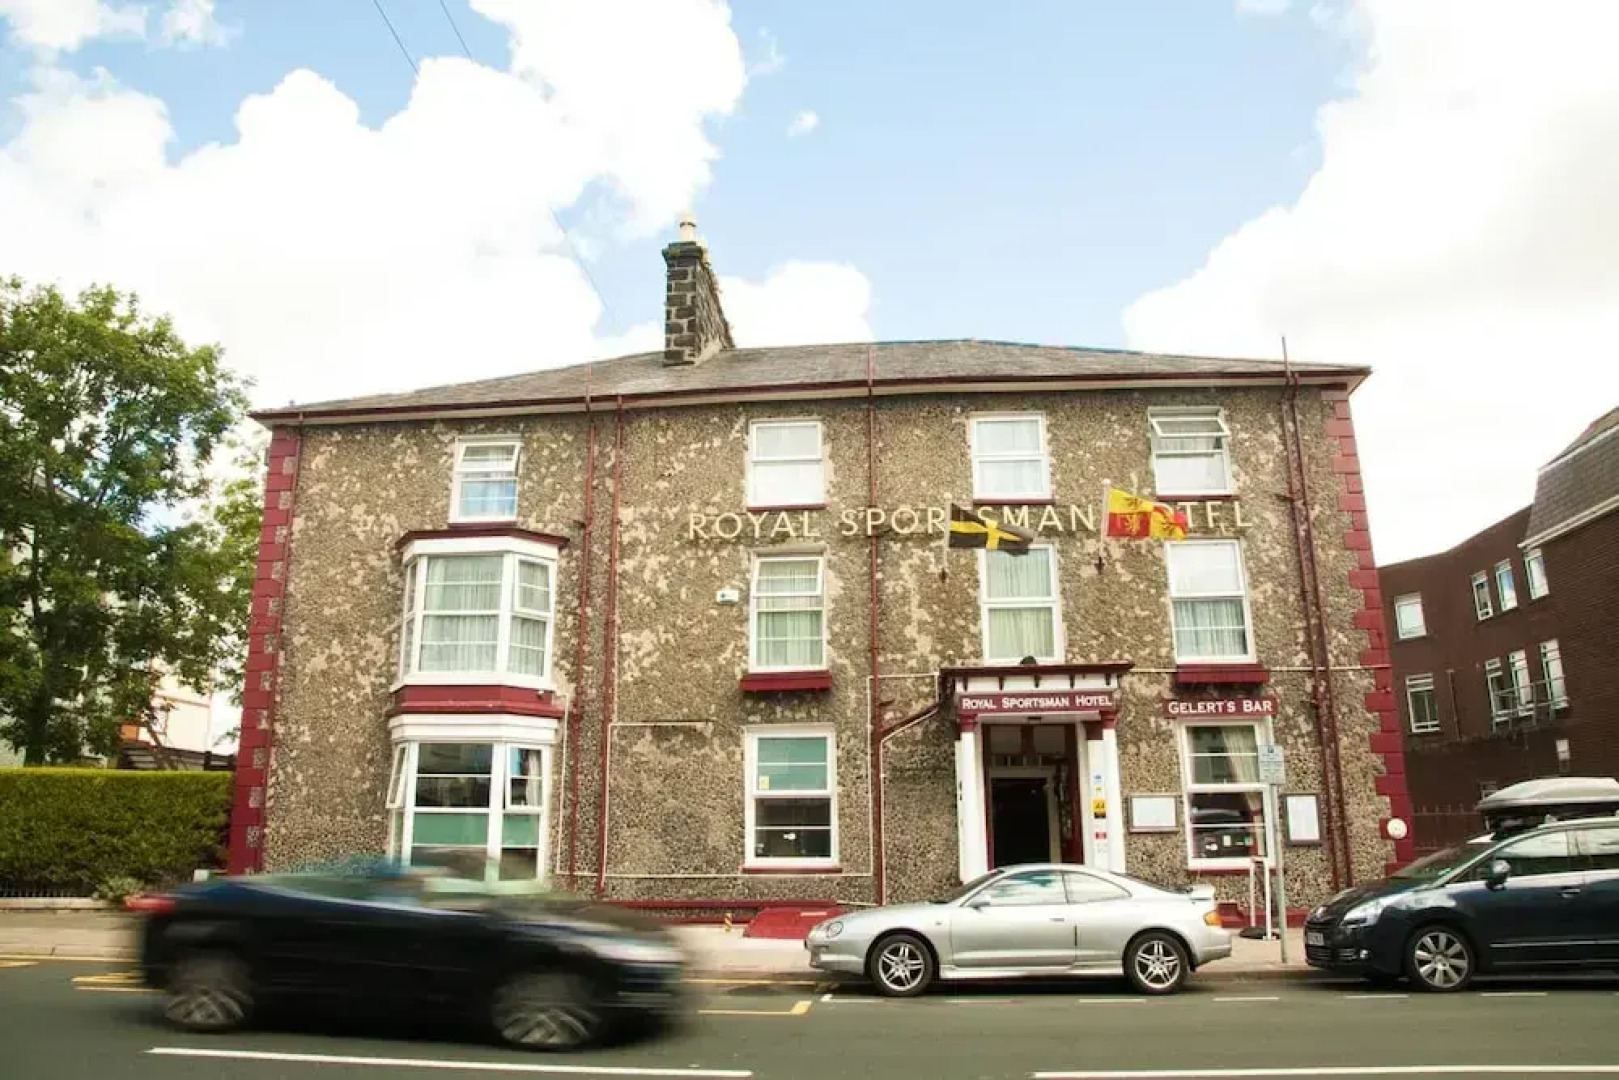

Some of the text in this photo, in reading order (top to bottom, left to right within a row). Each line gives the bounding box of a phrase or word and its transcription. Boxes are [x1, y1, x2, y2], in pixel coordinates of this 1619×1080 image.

[688, 511, 821, 540] ROYAL
[962, 695, 1112, 709] ROYAL SPORTSMAN HOTEL
[1168, 699, 1272, 714] GELERT'S BAR
